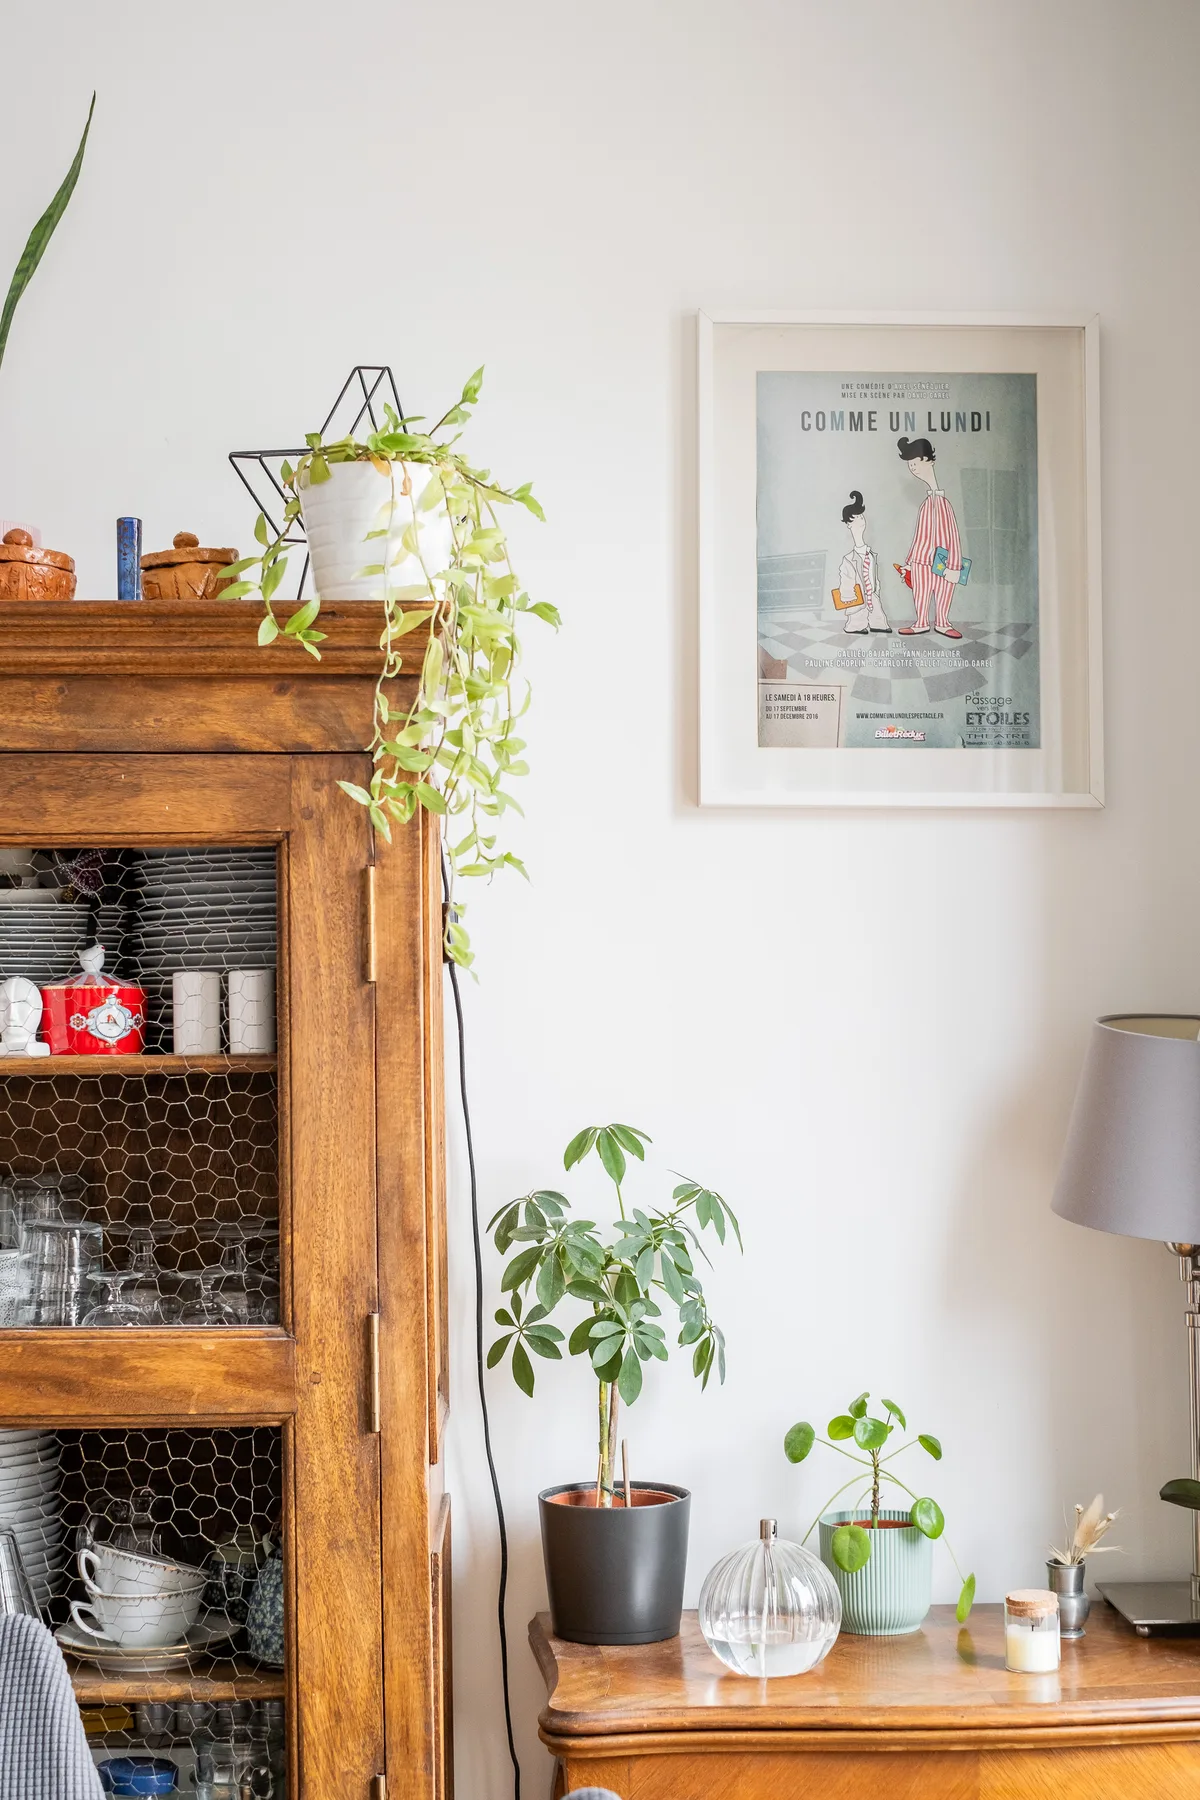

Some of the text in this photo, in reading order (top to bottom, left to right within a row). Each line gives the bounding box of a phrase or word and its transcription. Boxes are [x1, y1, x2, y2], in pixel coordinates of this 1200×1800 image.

[856, 382, 885, 390] COMÉDIE
[801, 410, 990, 432] COMME UN LUNDI
[902, 650, 920, 658] YANN
[922, 650, 961, 658] CHEVALIER
[804, 660, 993, 668] PAULINE CHOPLIN CHARLOTTE GALLET DAVID GAREL
[765, 693, 773, 702] LE
[773, 693, 796, 702] SAMEDI
[803, 693, 811, 702] 18
[965, 695, 1012, 707] Passage
[966, 711, 1030, 725] ETOILES
